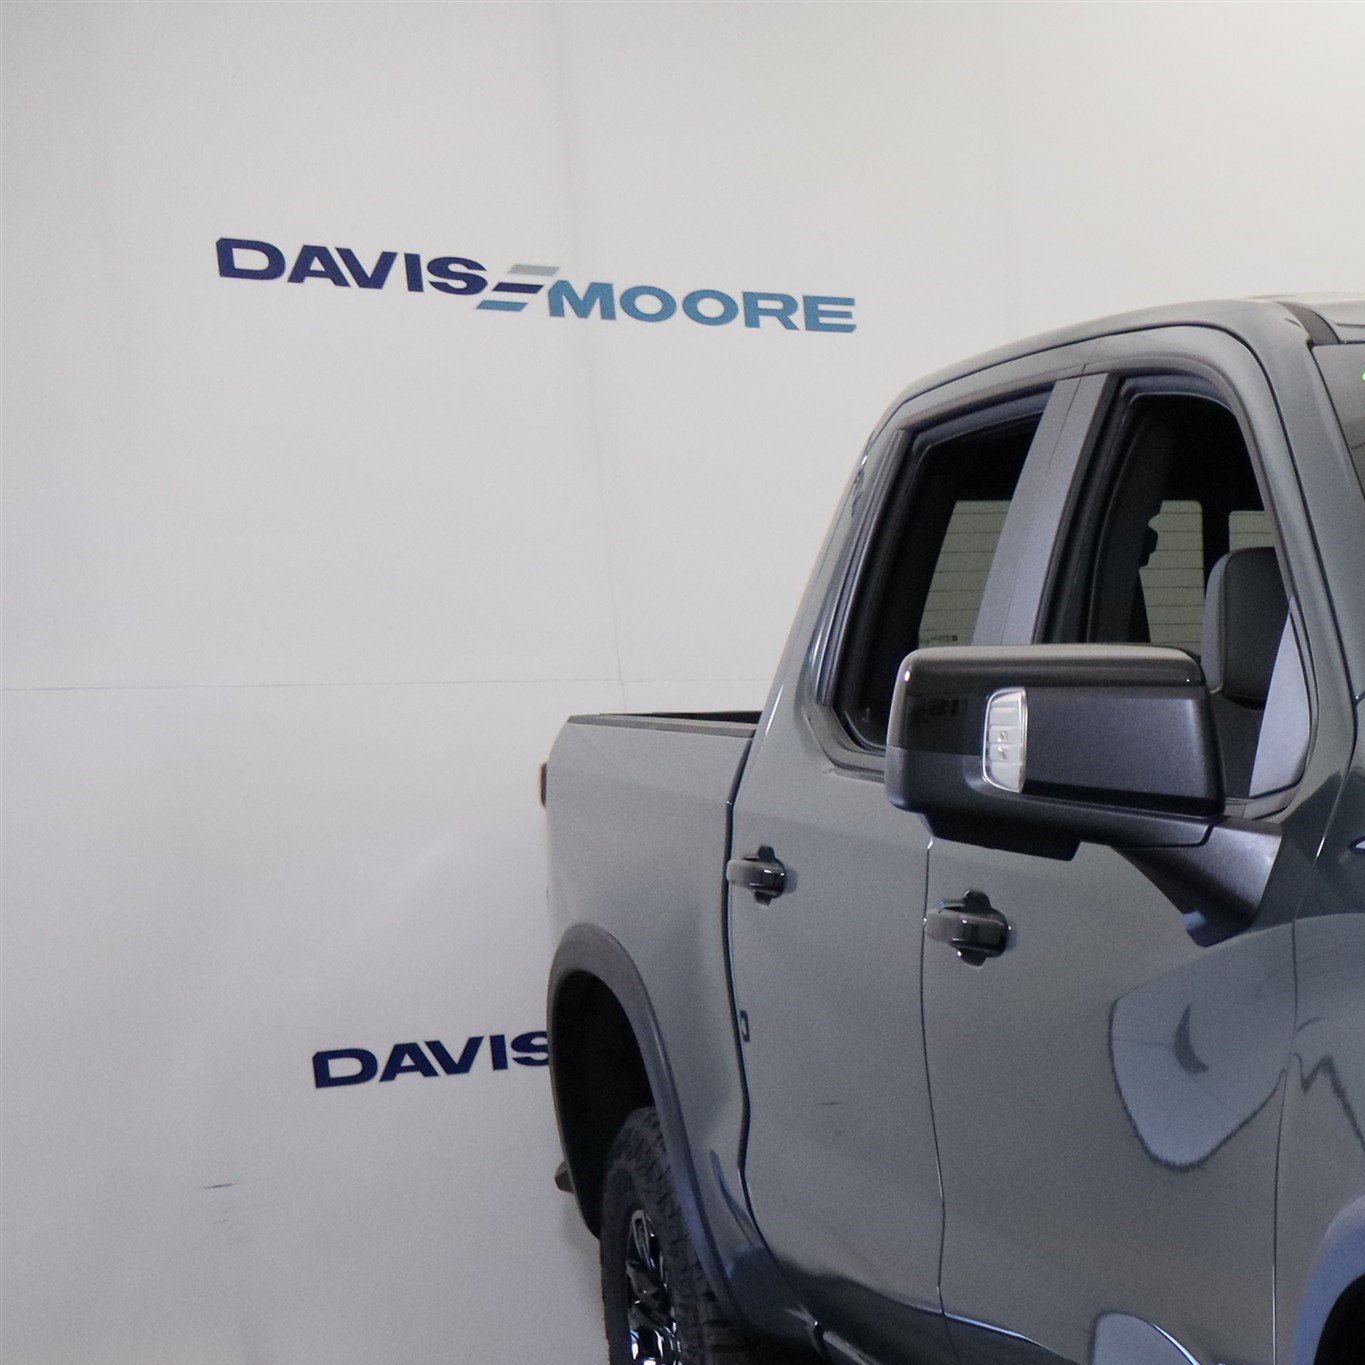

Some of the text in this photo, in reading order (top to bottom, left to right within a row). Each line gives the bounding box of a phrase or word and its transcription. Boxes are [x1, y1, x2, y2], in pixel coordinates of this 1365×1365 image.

[216, 237, 858, 334] DAVIS MOORE
[312, 1030, 549, 1089] DAVIS
